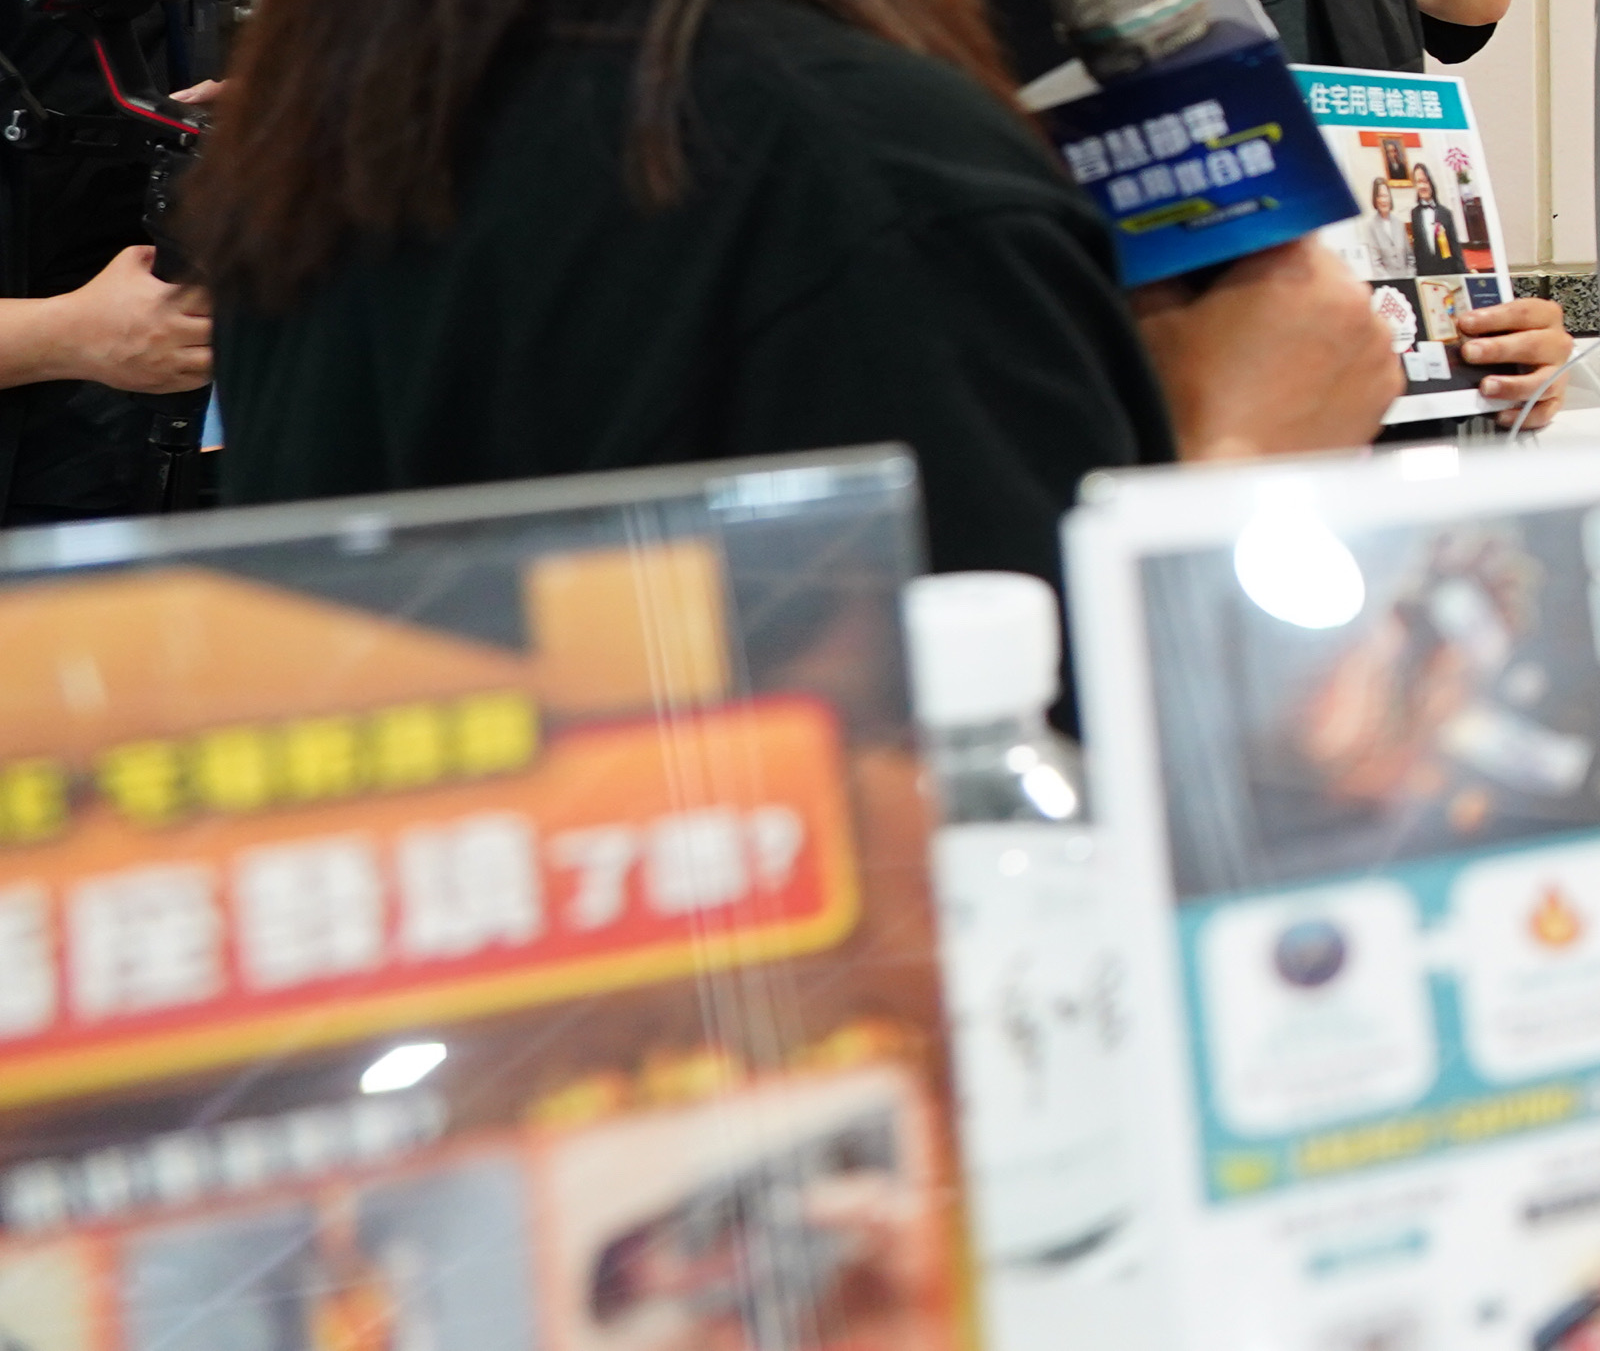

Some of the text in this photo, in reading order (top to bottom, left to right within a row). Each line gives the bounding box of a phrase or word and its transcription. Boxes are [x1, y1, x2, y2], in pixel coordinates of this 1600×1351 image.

[1309, 82, 1443, 119] 住宅用電檢測器
